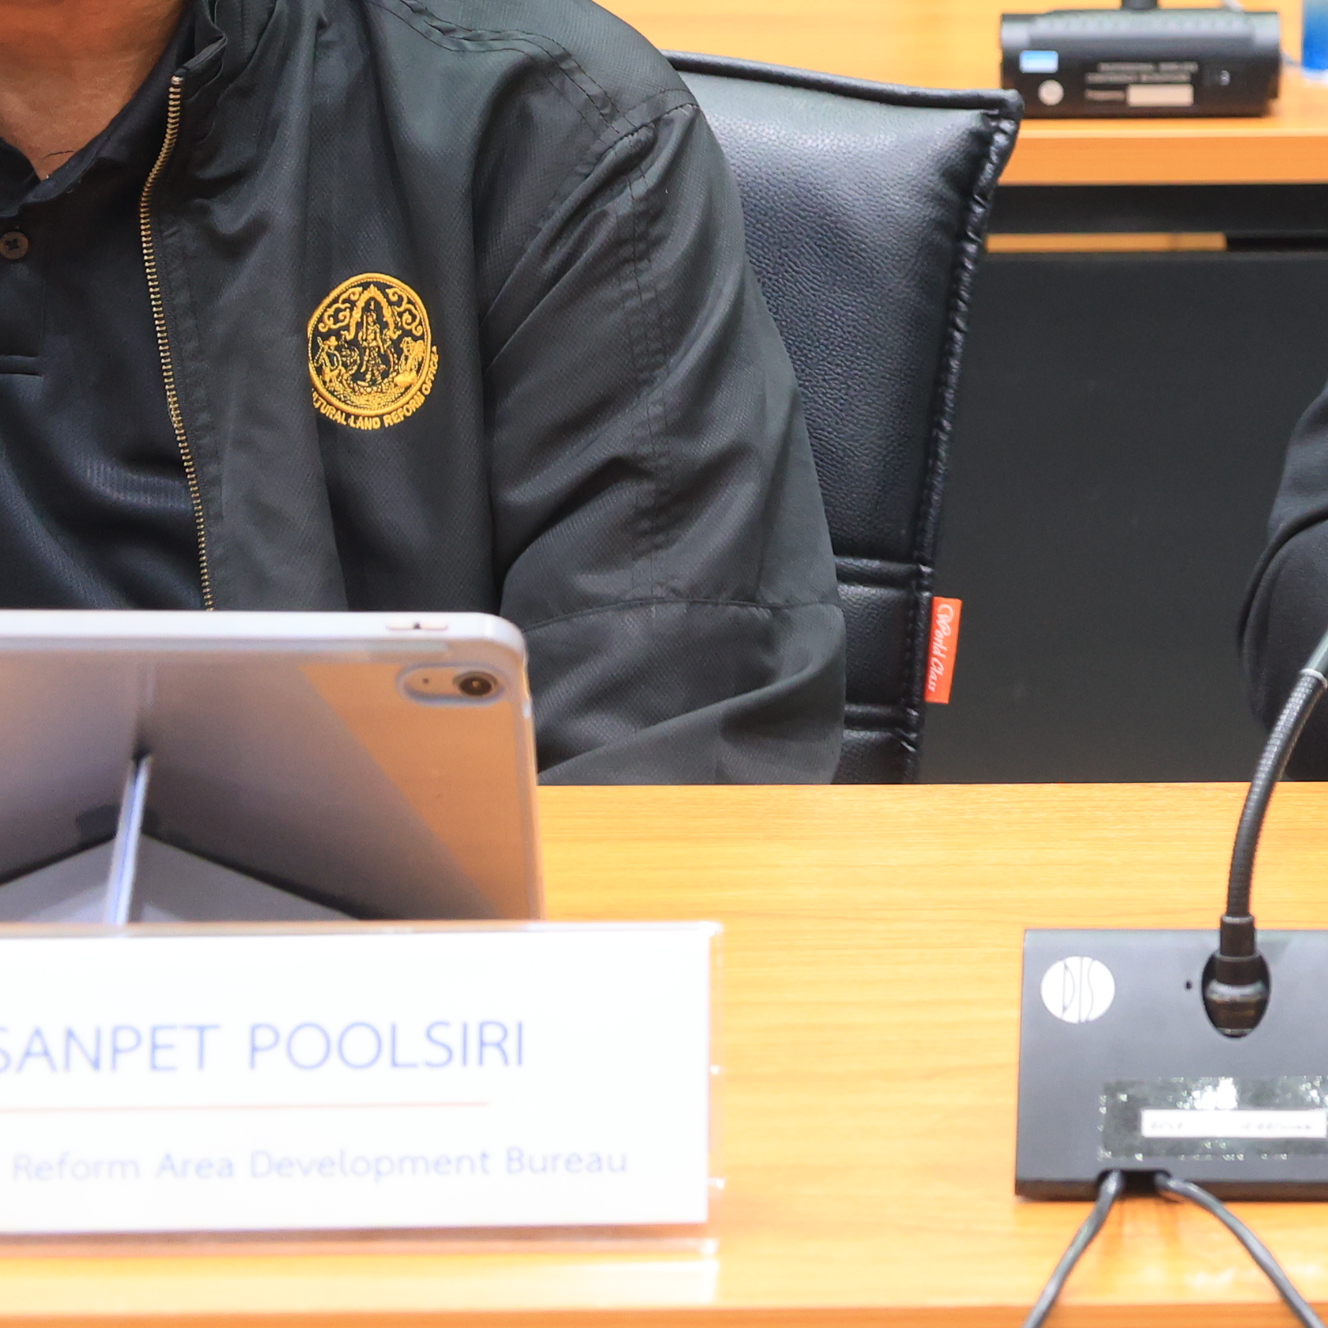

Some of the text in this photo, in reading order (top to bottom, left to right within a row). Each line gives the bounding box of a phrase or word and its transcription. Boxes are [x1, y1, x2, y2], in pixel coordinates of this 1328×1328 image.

[348, 415, 381, 430] LAND
[383, 394, 426, 427] REFORM
[927, 603, 954, 692] World Class
[249, 1020, 524, 1071] POOLSIRI
[12, 1146, 627, 1182] Reform Area Development Bureau
